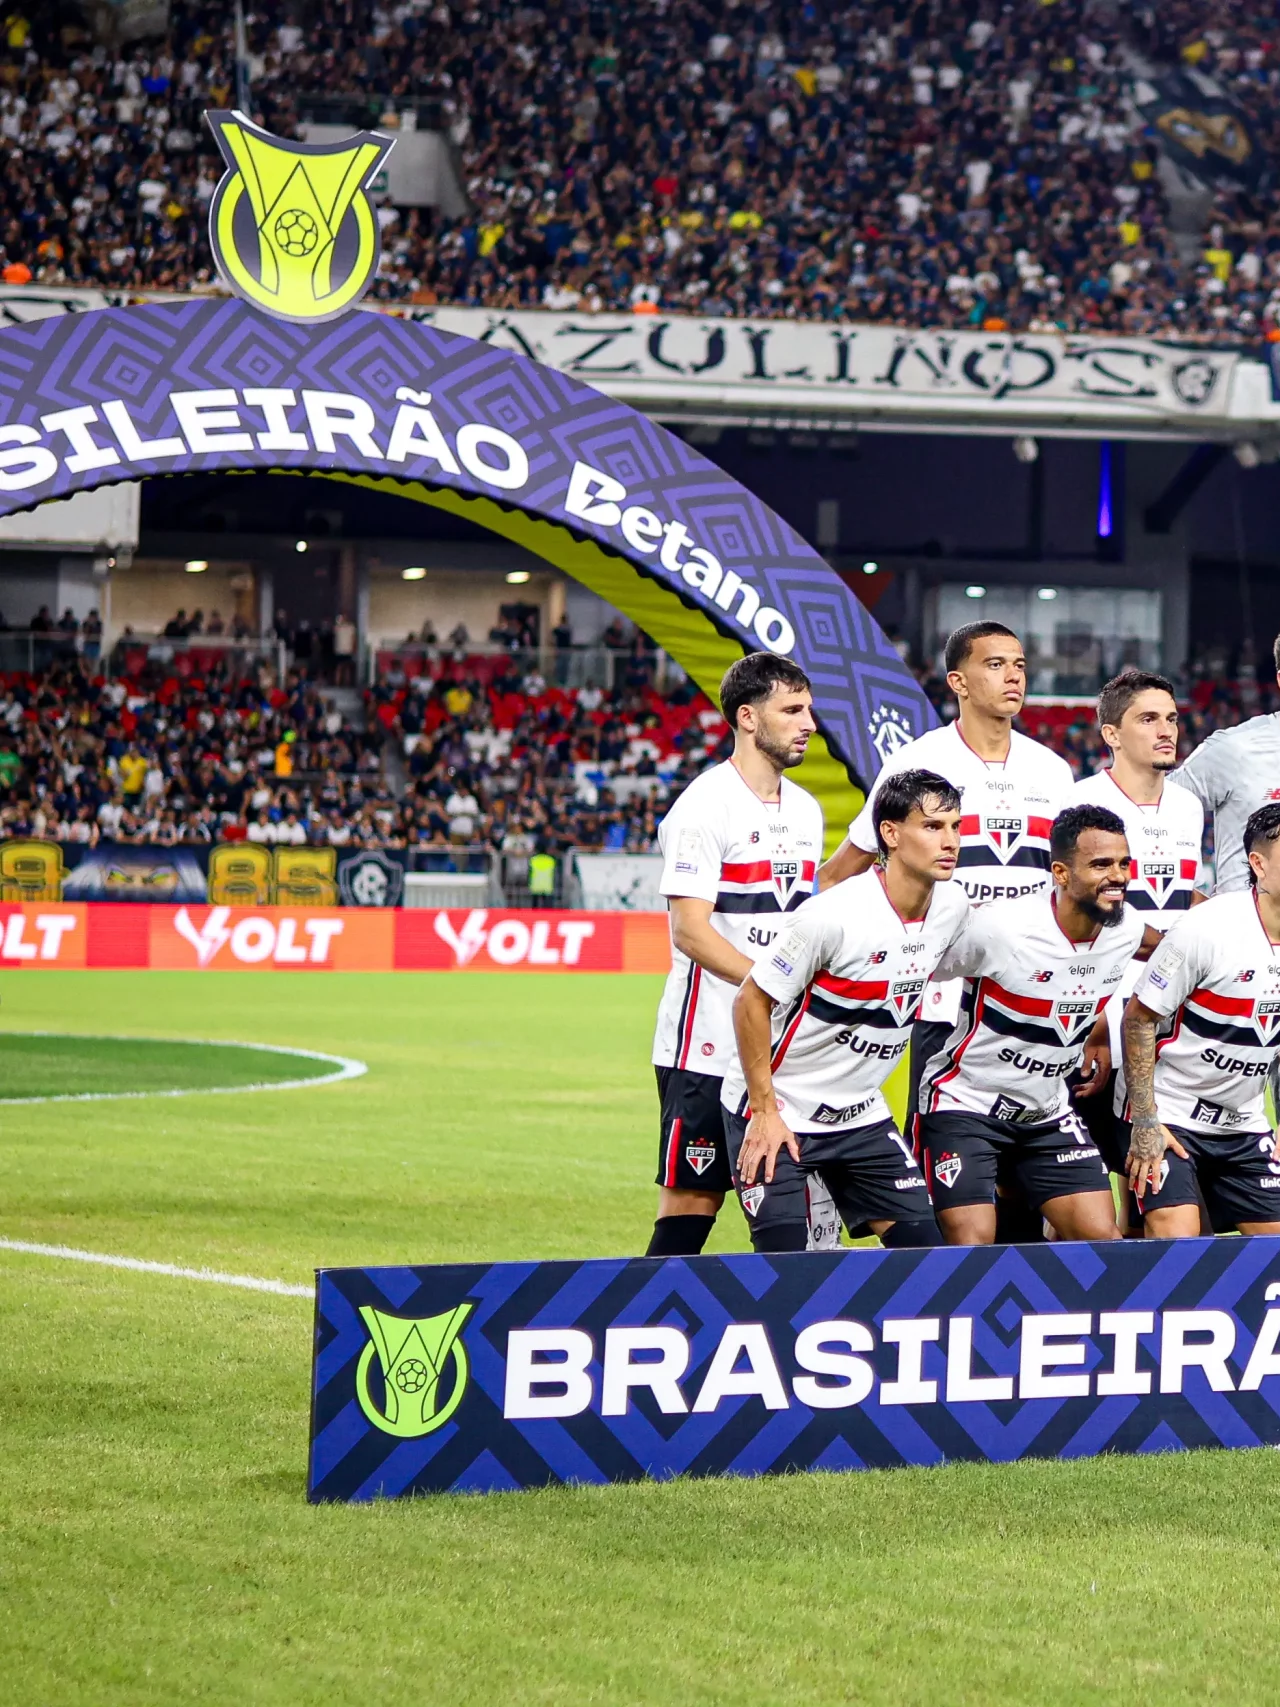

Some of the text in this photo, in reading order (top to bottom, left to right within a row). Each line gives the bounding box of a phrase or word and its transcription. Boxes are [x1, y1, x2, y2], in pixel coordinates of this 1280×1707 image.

[566, 459, 796, 655] Betano
[985, 781, 1015, 793] elgin
[987, 818, 1022, 830] SPFC
[1142, 827, 1169, 838] elgin
[208, 843, 337, 905] 85
[773, 862, 798, 874] SPFC
[1144, 864, 1175, 875] SPFC
[0, 914, 76, 960] LT
[174, 906, 344, 967] VOLT
[434, 910, 595, 966] VOLT
[901, 943, 925, 955] elgin
[1068, 965, 1095, 977] elgin
[894, 982, 923, 995] SPFC
[1060, 1003, 1093, 1014] SPFC
[688, 1149, 715, 1158] SPFC
[936, 1160, 959, 1174] SPFC
